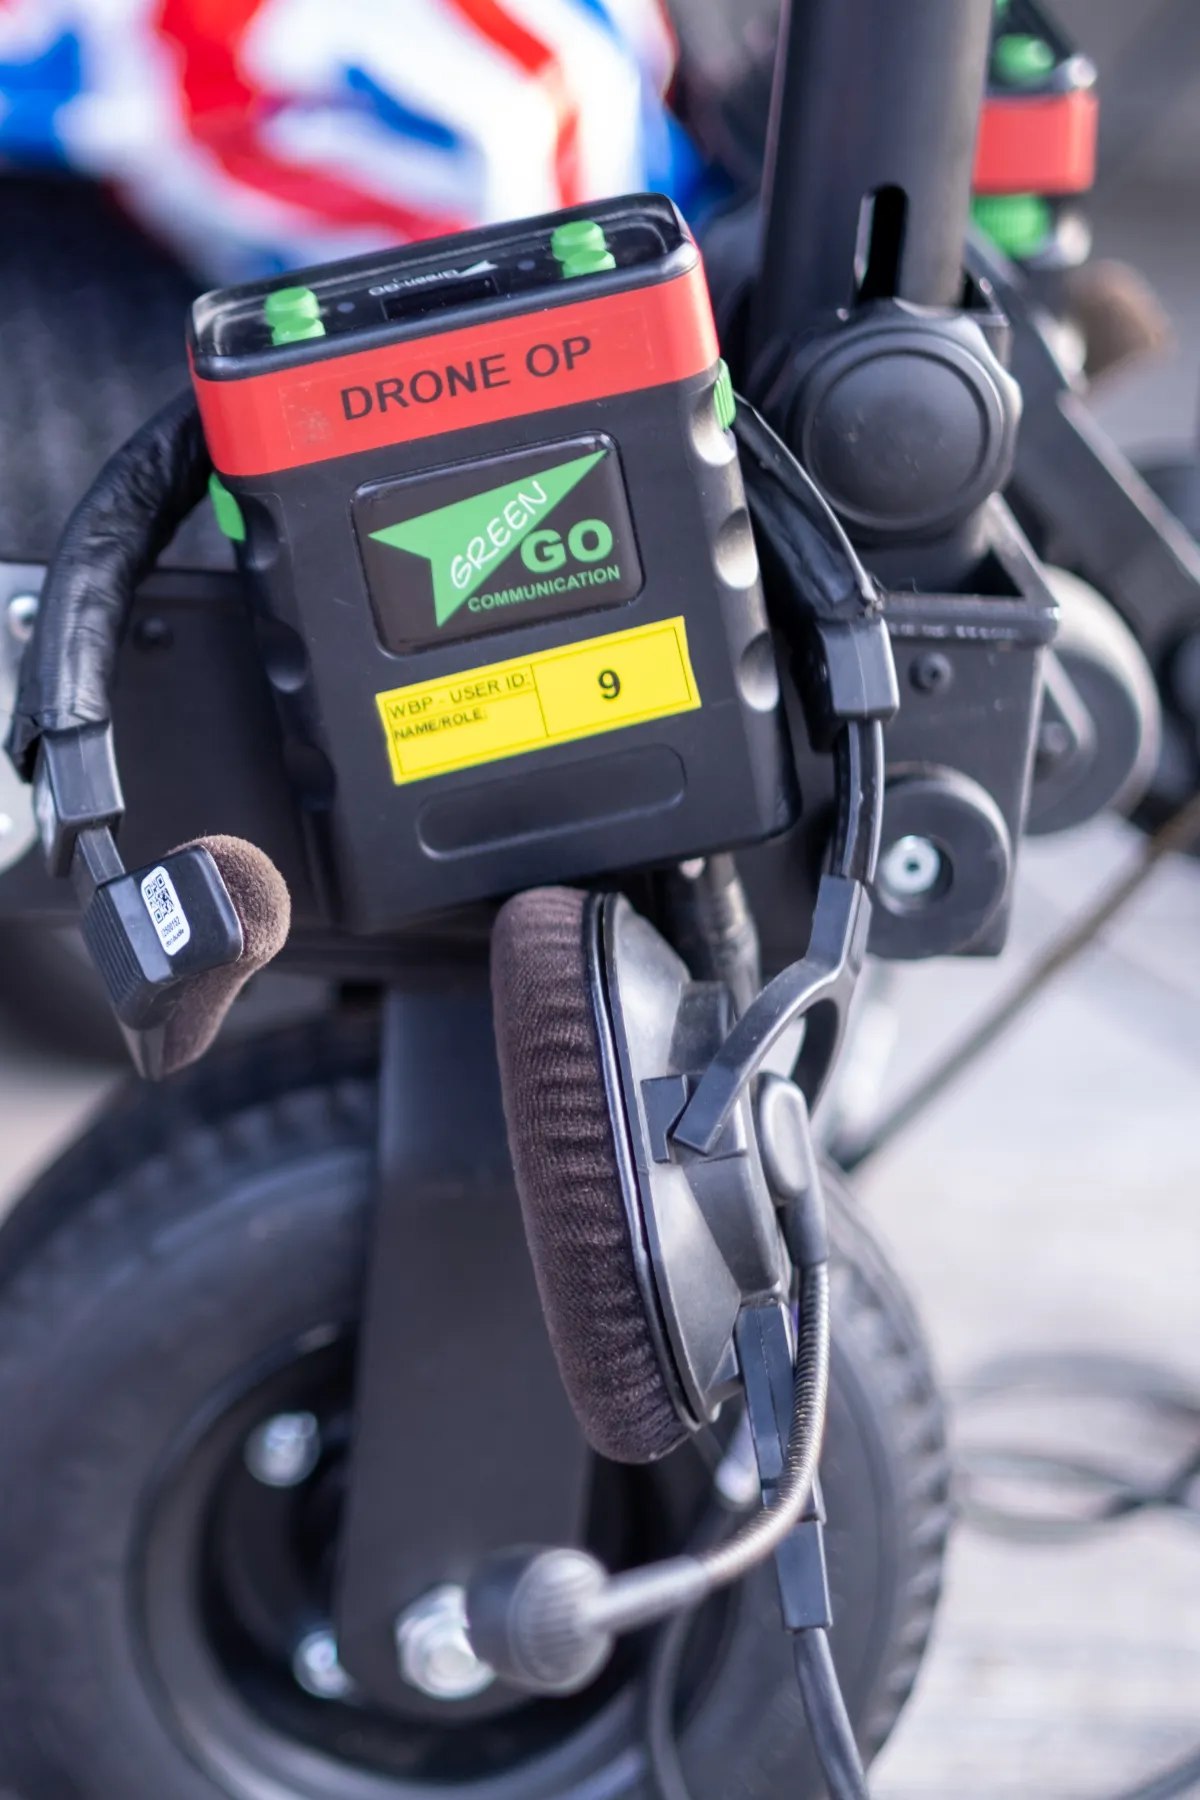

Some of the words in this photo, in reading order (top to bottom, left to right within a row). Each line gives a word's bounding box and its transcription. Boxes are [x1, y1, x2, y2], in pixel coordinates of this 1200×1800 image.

[341, 353, 510, 420] DRONE
[526, 335, 592, 377] OP
[450, 480, 548, 589] GREEN
[520, 518, 614, 574] GO
[468, 564, 621, 613] COMMUNICATION
[389, 695, 433, 720] WBP
[449, 678, 501, 705] USER
[506, 672, 532, 691] ID:
[597, 668, 621, 700] 9
[393, 706, 488, 741] NAME/ROLE:
